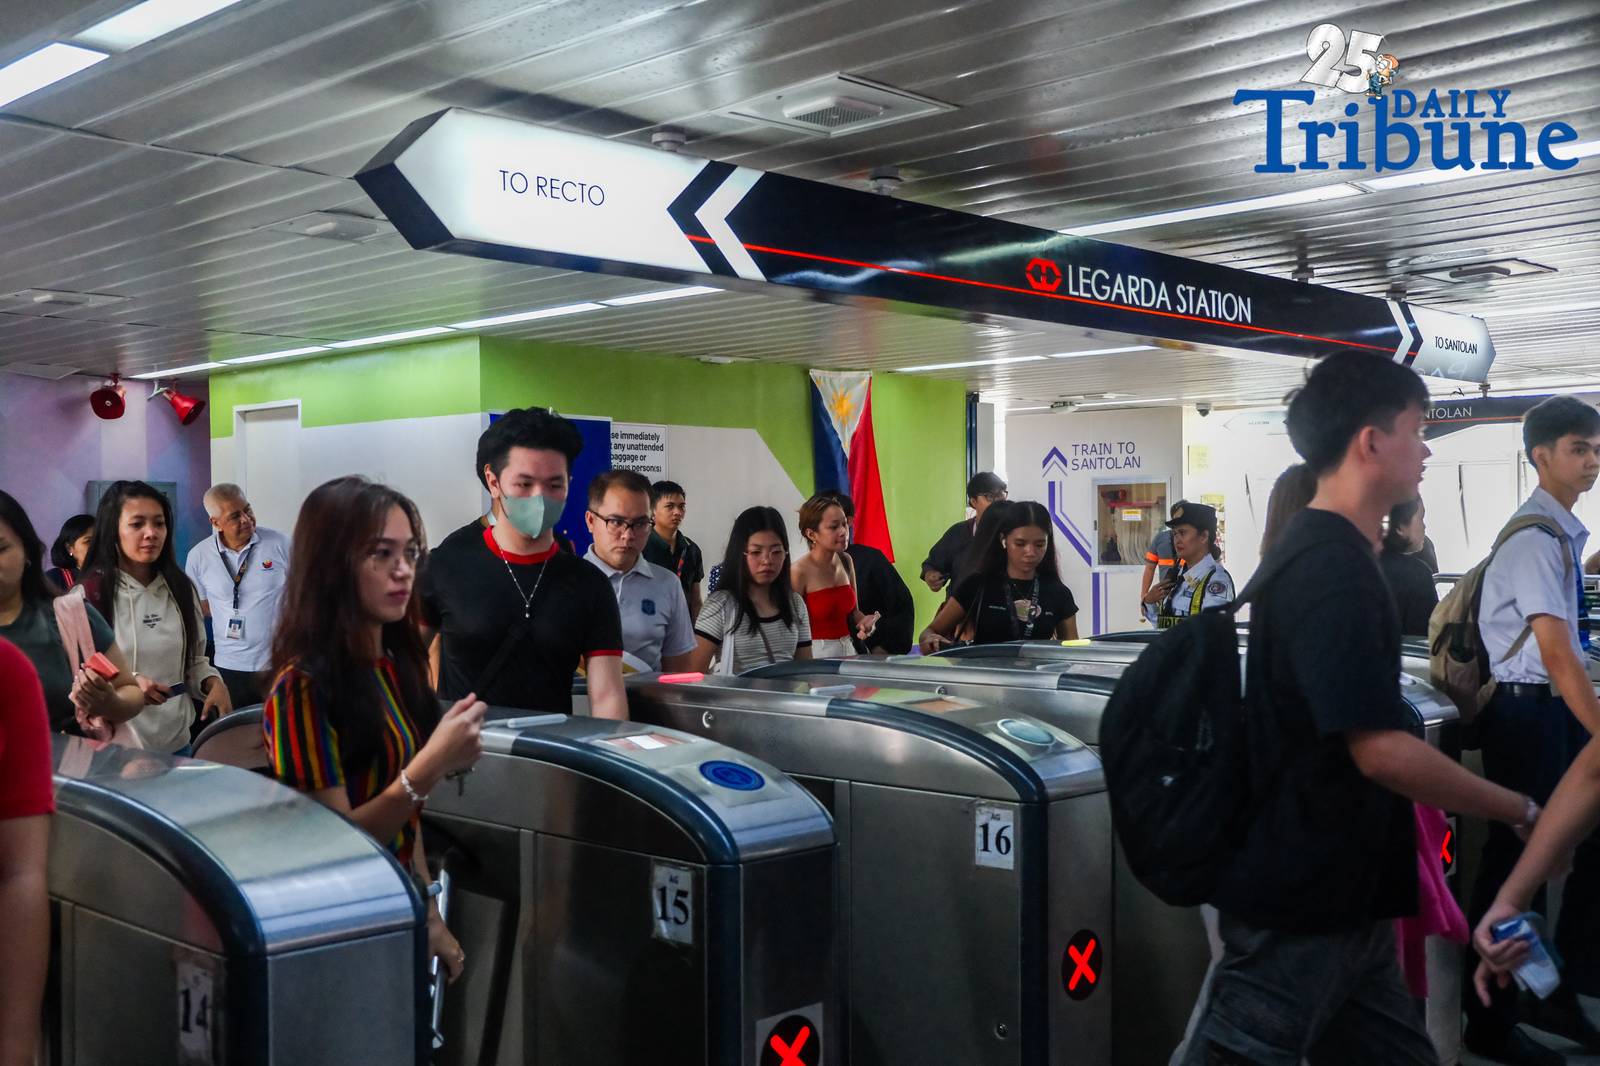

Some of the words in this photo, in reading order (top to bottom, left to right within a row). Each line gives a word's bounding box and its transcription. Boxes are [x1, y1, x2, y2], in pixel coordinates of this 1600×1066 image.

[498, 168, 529, 194] TO
[536, 175, 605, 206] RECTO
[1068, 264, 1172, 312] LEGARDA
[1176, 283, 1252, 324] STATION
[1434, 335, 1445, 349] TO
[1445, 337, 1478, 355] SANTOLAN
[620, 430, 660, 443] immediately
[613, 443, 625, 452] any
[626, 443, 664, 452] unattended
[1071, 442, 1112, 457] TRAIN
[1117, 441, 1136, 455] TO
[1071, 456, 1141, 471] SANTOLAN
[979, 822, 1011, 856] 16
[656, 885, 689, 925] 15
